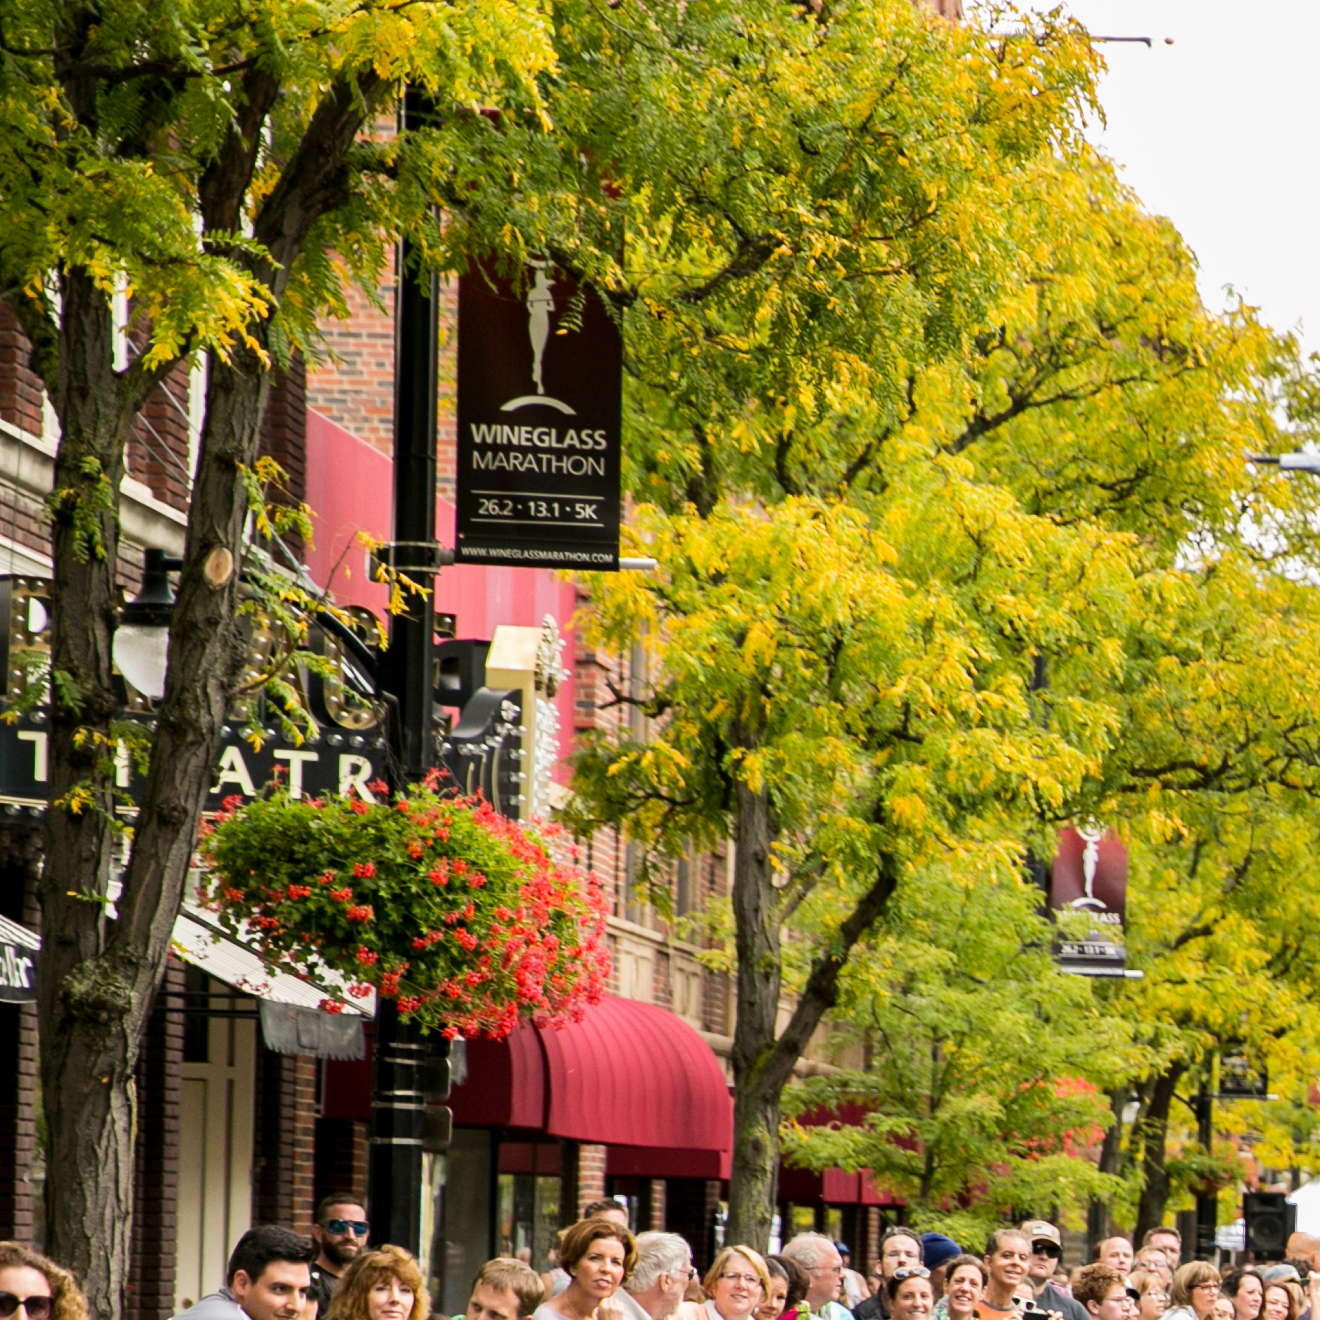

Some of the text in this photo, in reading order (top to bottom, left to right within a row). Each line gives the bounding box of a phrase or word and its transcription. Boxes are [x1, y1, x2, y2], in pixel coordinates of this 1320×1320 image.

[470, 423, 608, 450] WINEGLASS
[472, 450, 605, 476] MARATHON
[478, 499, 598, 520] 26.2 13.1 5K
[461, 547, 614, 563] WWW.WINEGLASSMARATHON.COM
